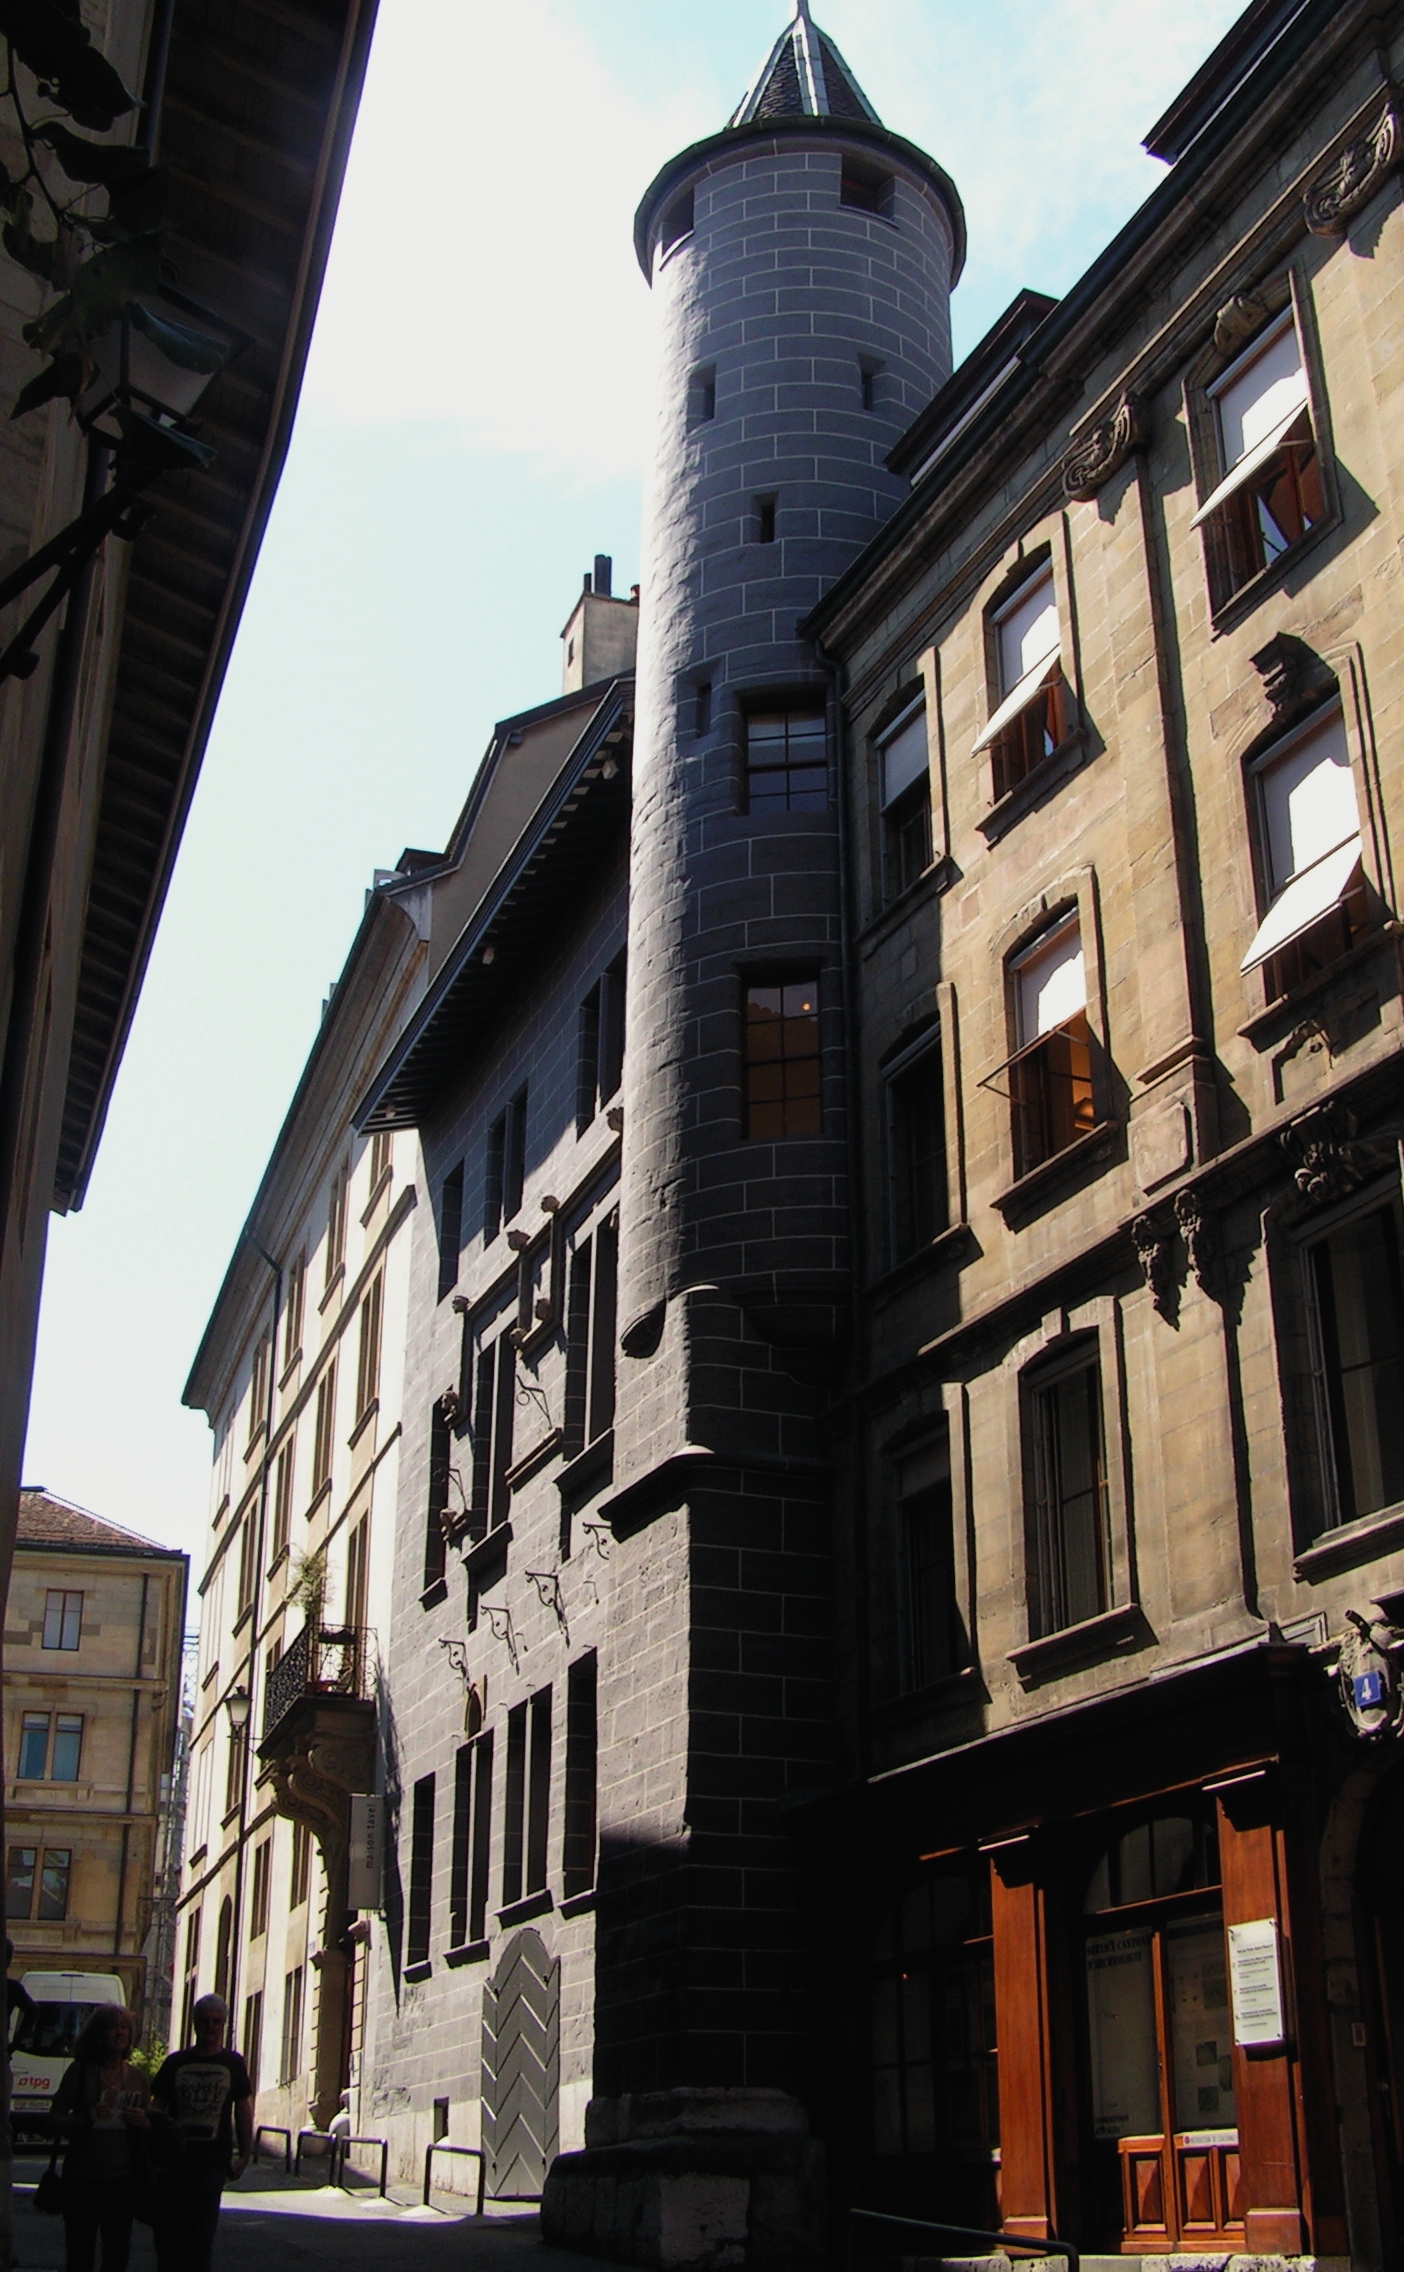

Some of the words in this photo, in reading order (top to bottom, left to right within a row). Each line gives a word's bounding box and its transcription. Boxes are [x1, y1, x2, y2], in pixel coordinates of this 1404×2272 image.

[1361, 1677, 1372, 1700] 4
[366, 1803, 376, 1829] tavel
[366, 1833, 374, 1869] maison
[30, 2076, 50, 2090] tpg
